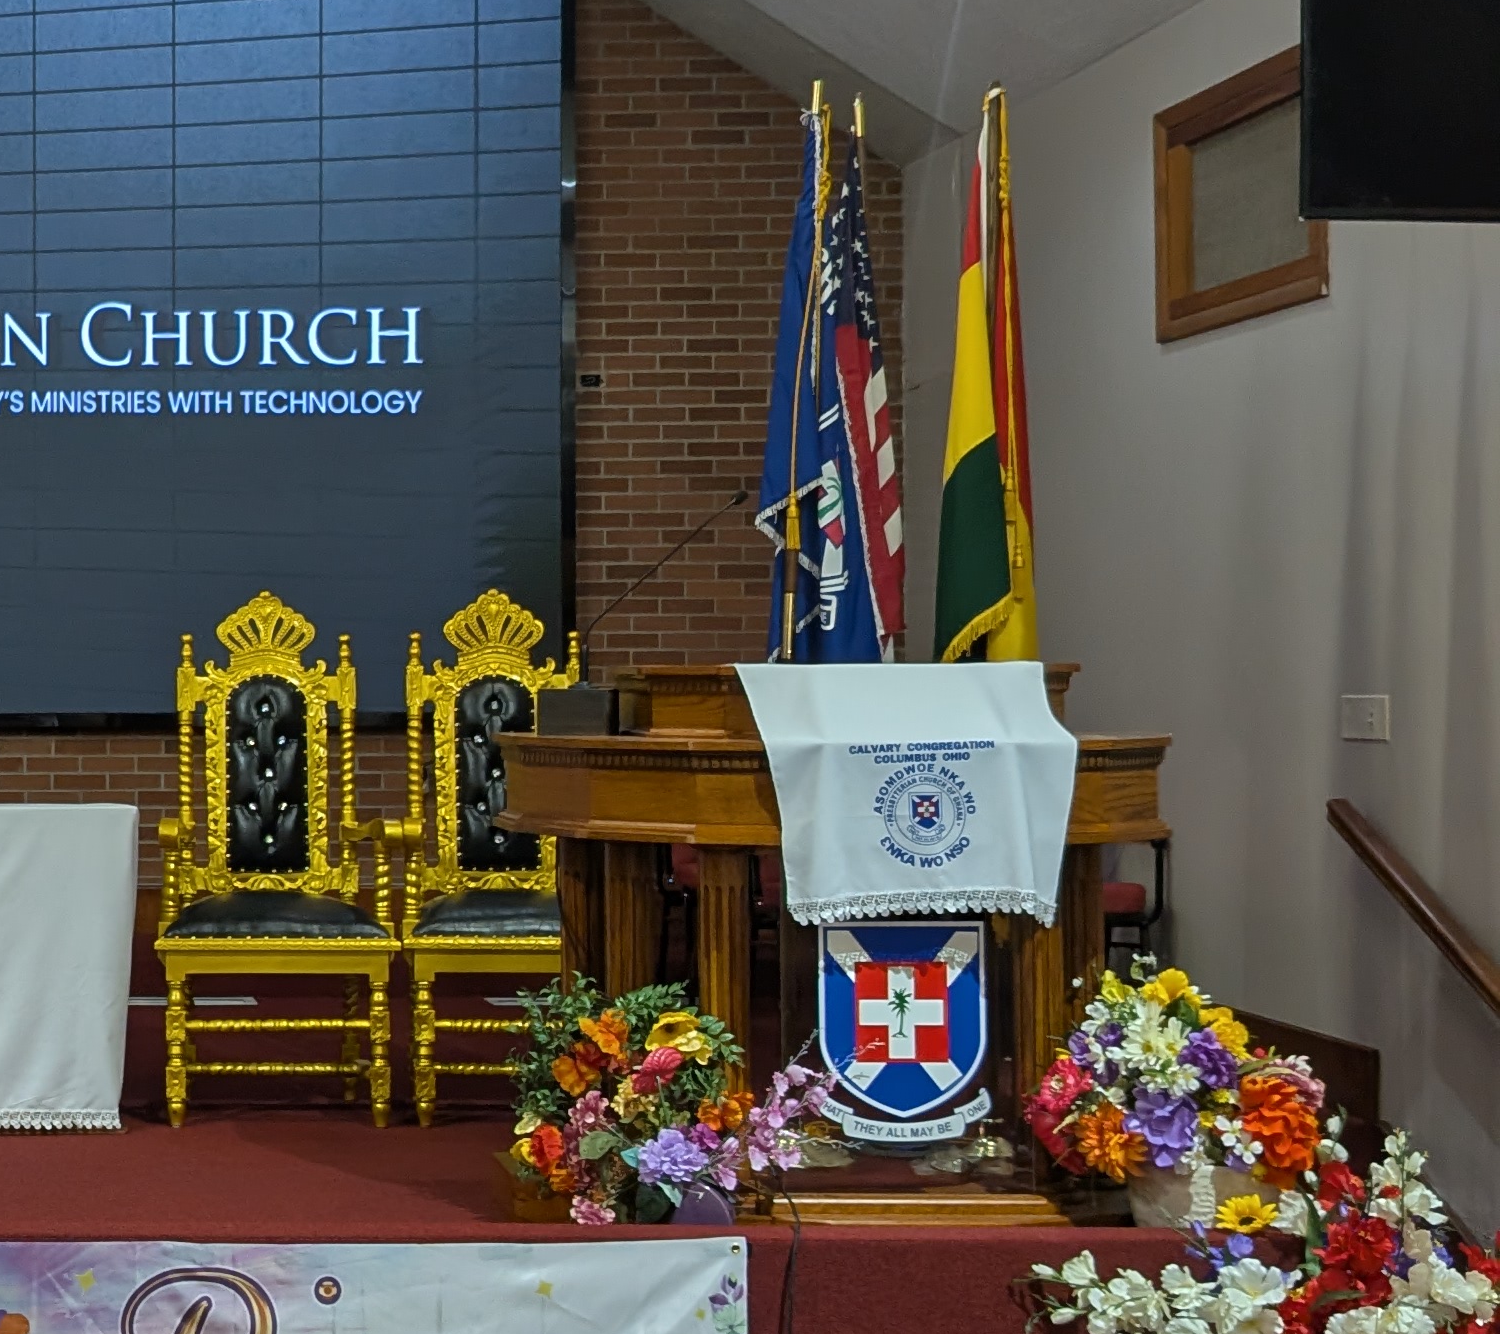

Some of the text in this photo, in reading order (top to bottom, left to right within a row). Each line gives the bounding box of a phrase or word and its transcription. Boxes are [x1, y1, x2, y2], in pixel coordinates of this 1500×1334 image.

[31, 389, 161, 414] MINISTRIES
[168, 389, 233, 414] WITH
[240, 389, 423, 414] TECHNOLOGY
[849, 741, 995, 754] CALVARY CONGREGATION
[874, 752, 970, 764] COLUMBUS OHIO
[874, 764, 975, 814] ASOMDWOE NKA WO
[920, 856, 943, 867] WO
[945, 837, 970, 862] NSO
[822, 1101, 844, 1118] HAT
[967, 1100, 987, 1117] ONE
[854, 1121, 953, 1138] THEY ALL MAY BE
